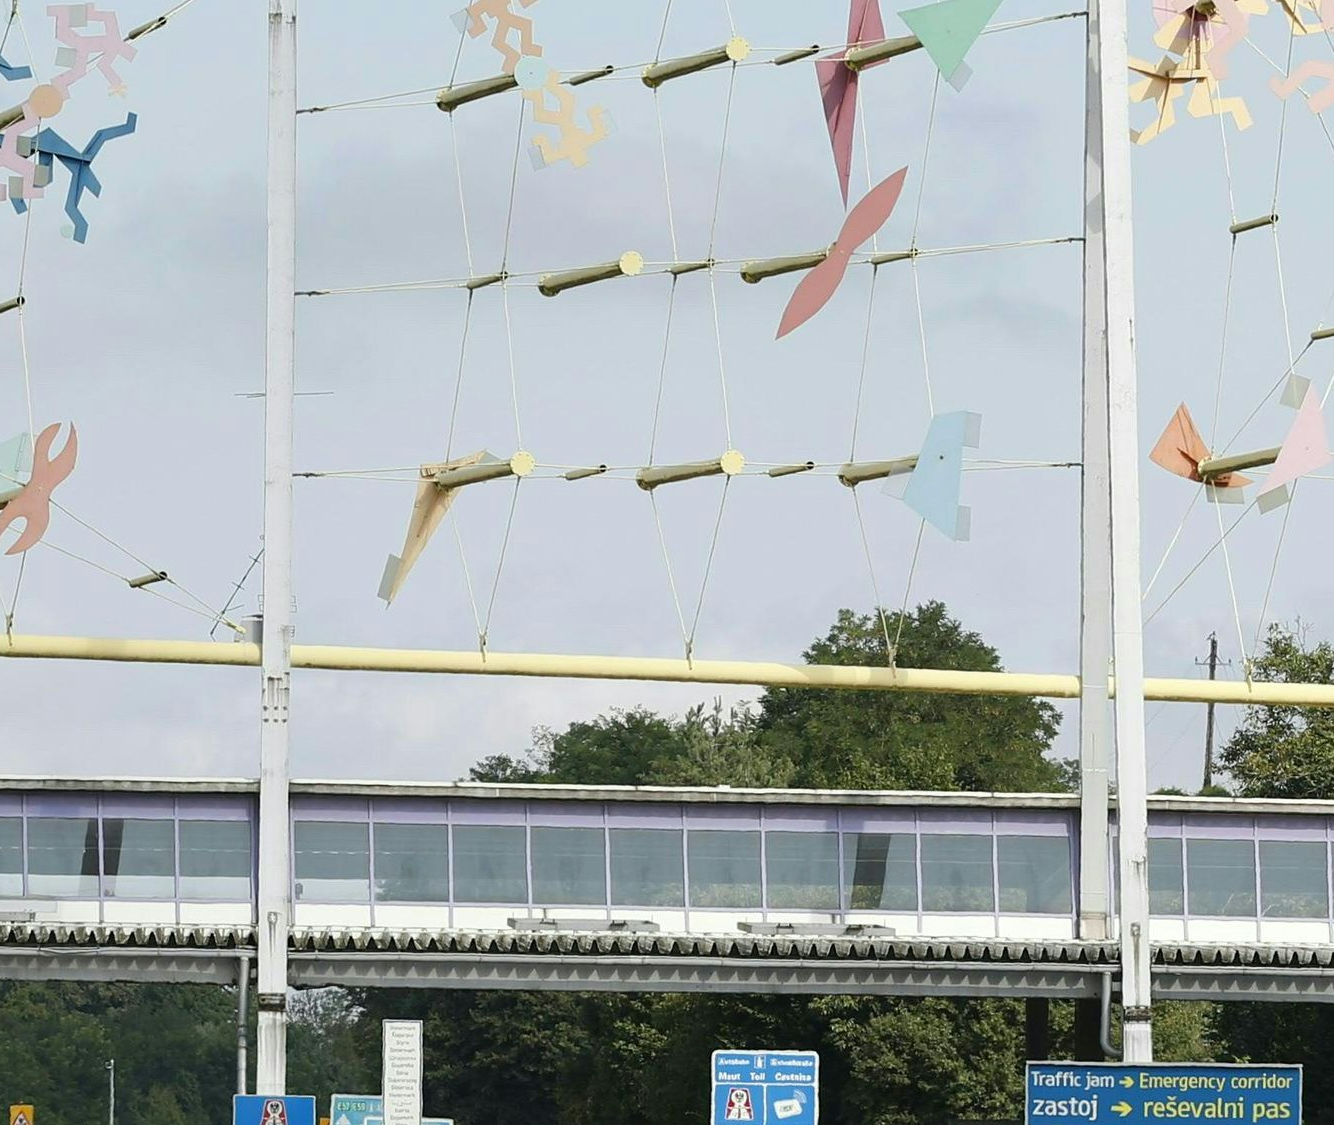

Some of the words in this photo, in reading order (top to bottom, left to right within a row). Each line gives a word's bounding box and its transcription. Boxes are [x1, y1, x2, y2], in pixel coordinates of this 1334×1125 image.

[718, 1072, 741, 1081] Maut
[750, 1072, 766, 1081] Toll
[1030, 1070, 1082, 1088] Traffic
[1084, 1071, 1116, 1091] jam
[1139, 1072, 1225, 1093] Emergency
[1231, 1073, 1293, 1089] corridor
[1032, 1094, 1099, 1121] zastoj
[1143, 1095, 1244, 1119] reševalni
[1252, 1101, 1292, 1123] pas
